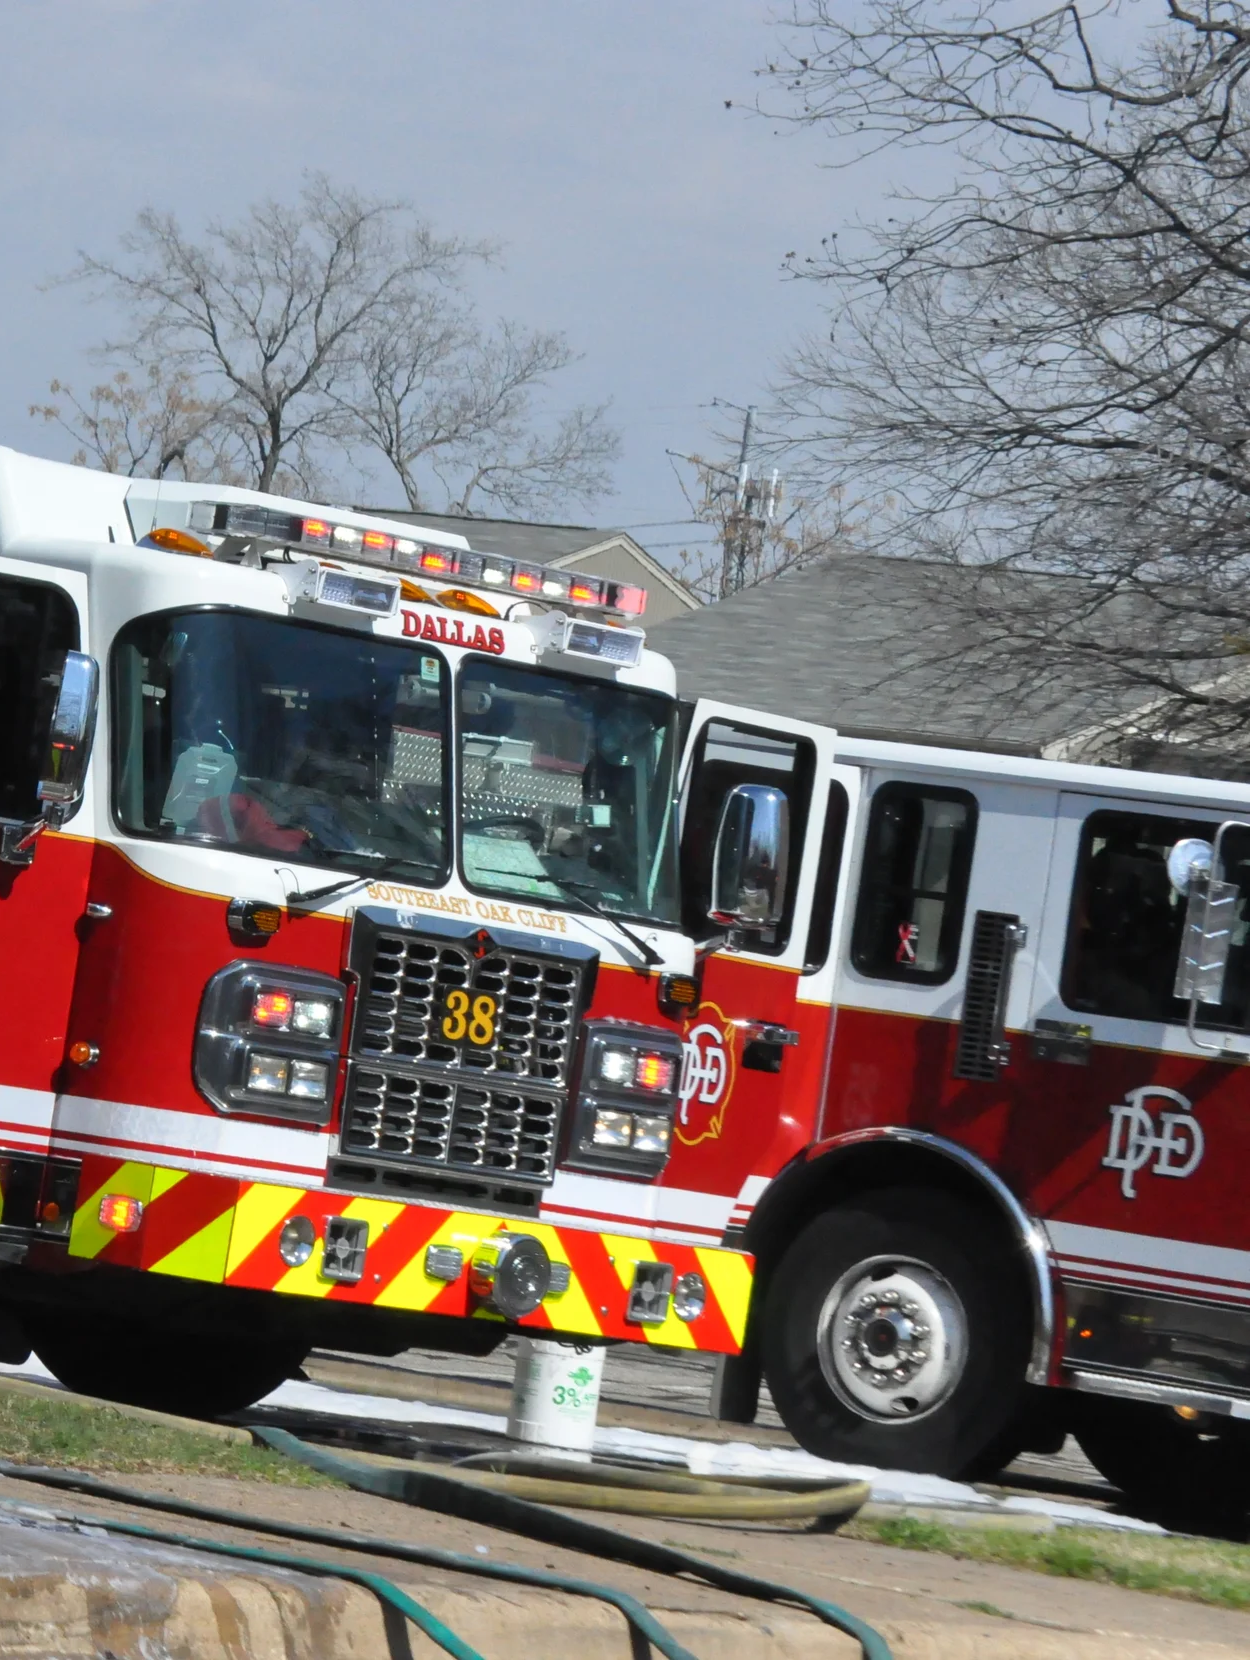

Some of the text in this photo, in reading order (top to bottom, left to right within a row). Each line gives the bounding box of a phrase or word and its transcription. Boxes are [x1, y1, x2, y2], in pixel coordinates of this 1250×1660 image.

[400, 609, 505, 655] DALLAS
[366, 884, 567, 933] SOUTHEAST OAK CLIFF
[443, 990, 495, 1045] 38
[552, 1385, 581, 1408] 3%
